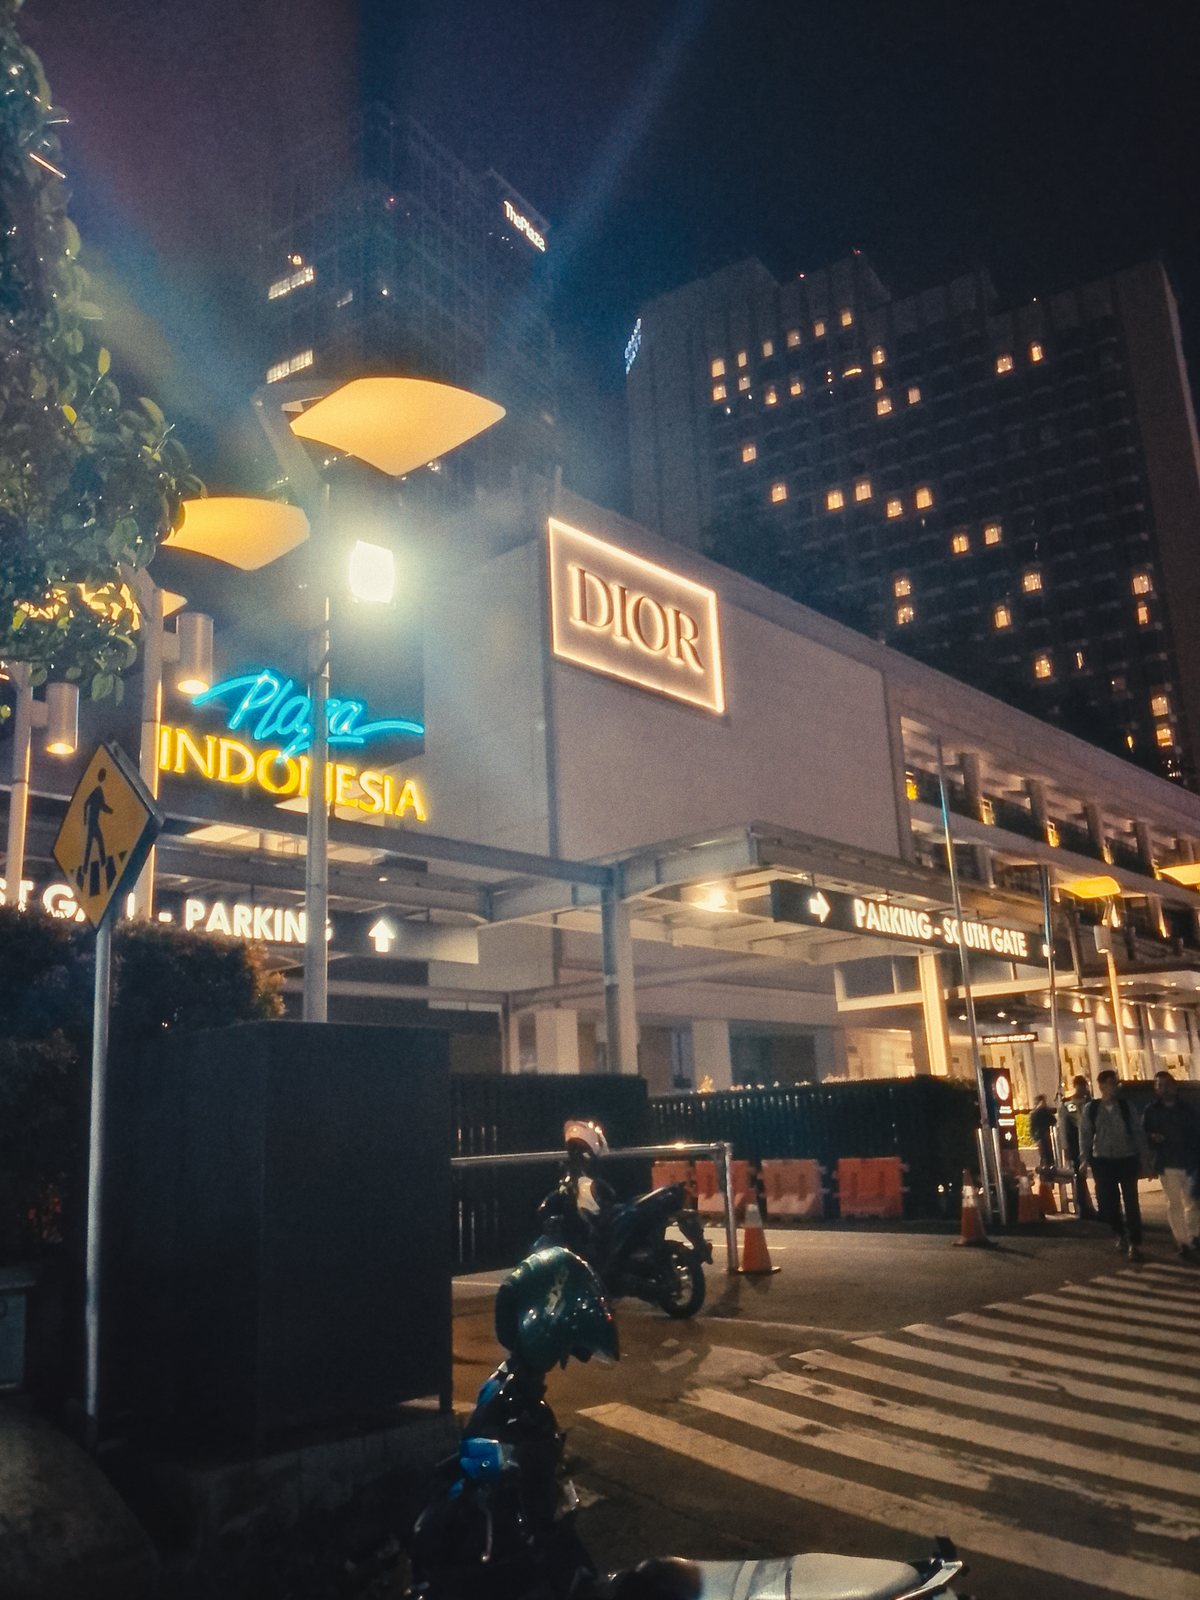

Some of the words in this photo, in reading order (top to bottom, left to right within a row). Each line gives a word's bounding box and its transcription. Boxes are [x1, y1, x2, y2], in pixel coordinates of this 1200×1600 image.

[569, 565, 704, 674] DIOR
[186, 898, 333, 943] PARKIN
[853, 898, 933, 940] PARKING
[991, 927, 1028, 957] GATE
